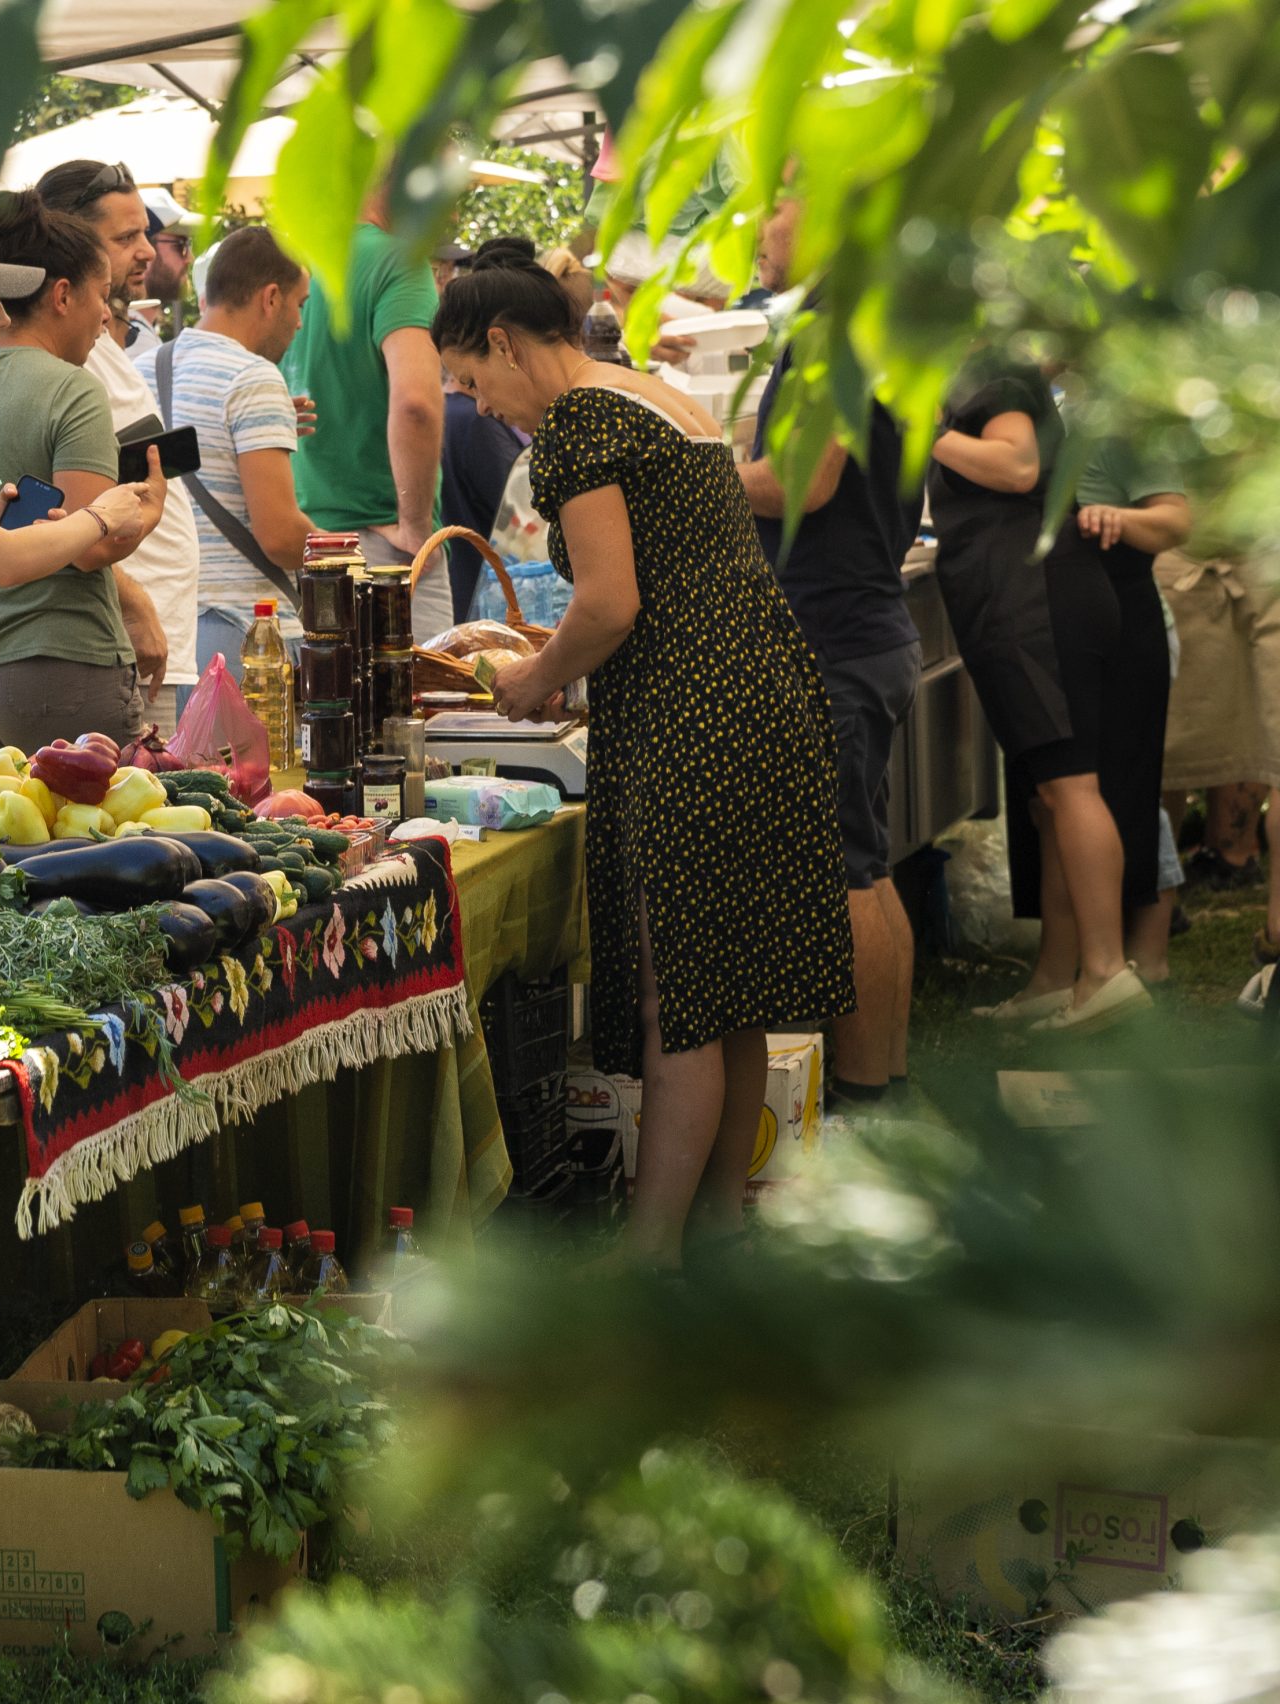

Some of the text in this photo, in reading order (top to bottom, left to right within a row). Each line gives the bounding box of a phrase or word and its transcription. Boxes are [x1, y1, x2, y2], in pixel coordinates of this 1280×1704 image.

[7, 1555, 15, 1567] 2
[23, 1556, 30, 1568] 3
[7, 1576, 15, 1587] 5
[23, 1576, 31, 1588] 6
[39, 1577, 47, 1588] 7
[55, 1577, 63, 1589] 8
[71, 1577, 79, 1590] 9
